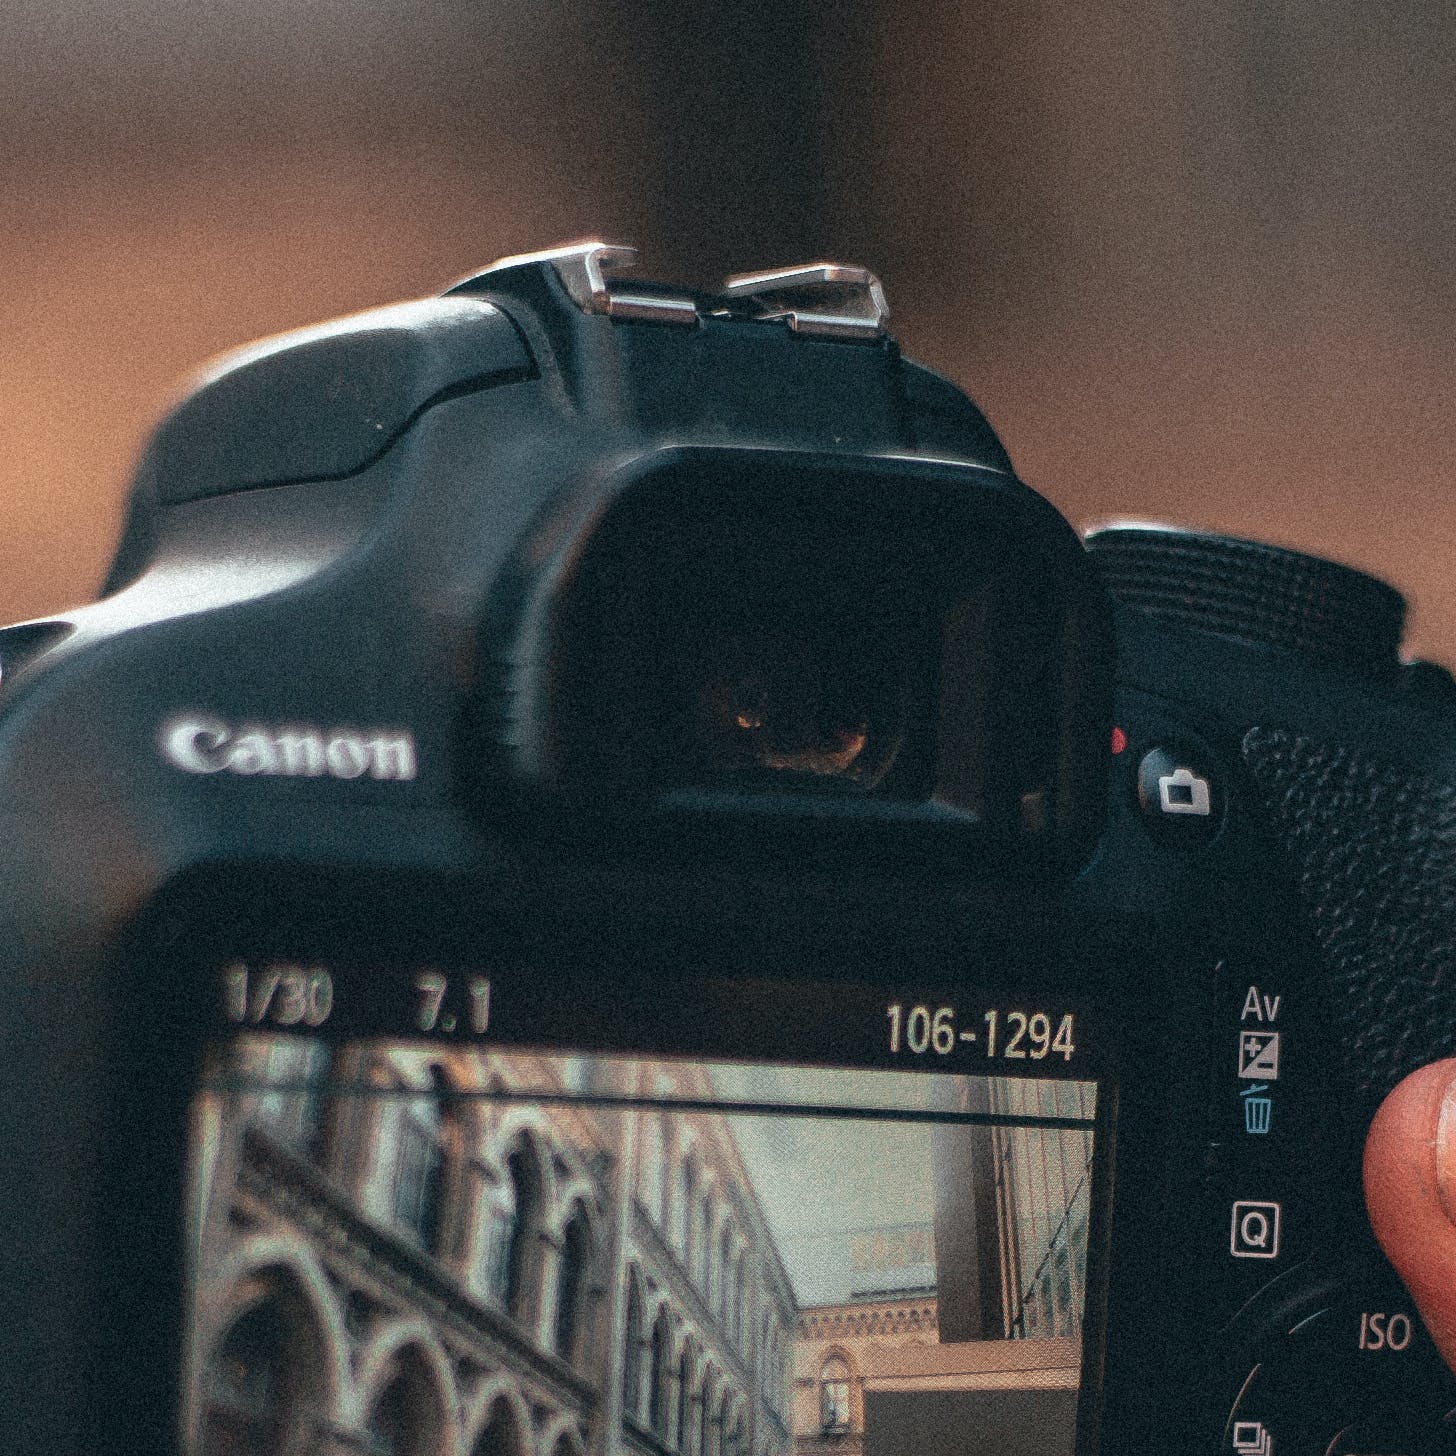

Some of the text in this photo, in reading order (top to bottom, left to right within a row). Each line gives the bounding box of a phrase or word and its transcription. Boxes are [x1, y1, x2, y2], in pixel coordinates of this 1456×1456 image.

[162, 716, 417, 781] Canon
[226, 962, 1074, 1061] 1/30 7.1 106-1294
[1241, 986, 1280, 1021] Av
[1359, 1312, 1411, 1350] ISO
